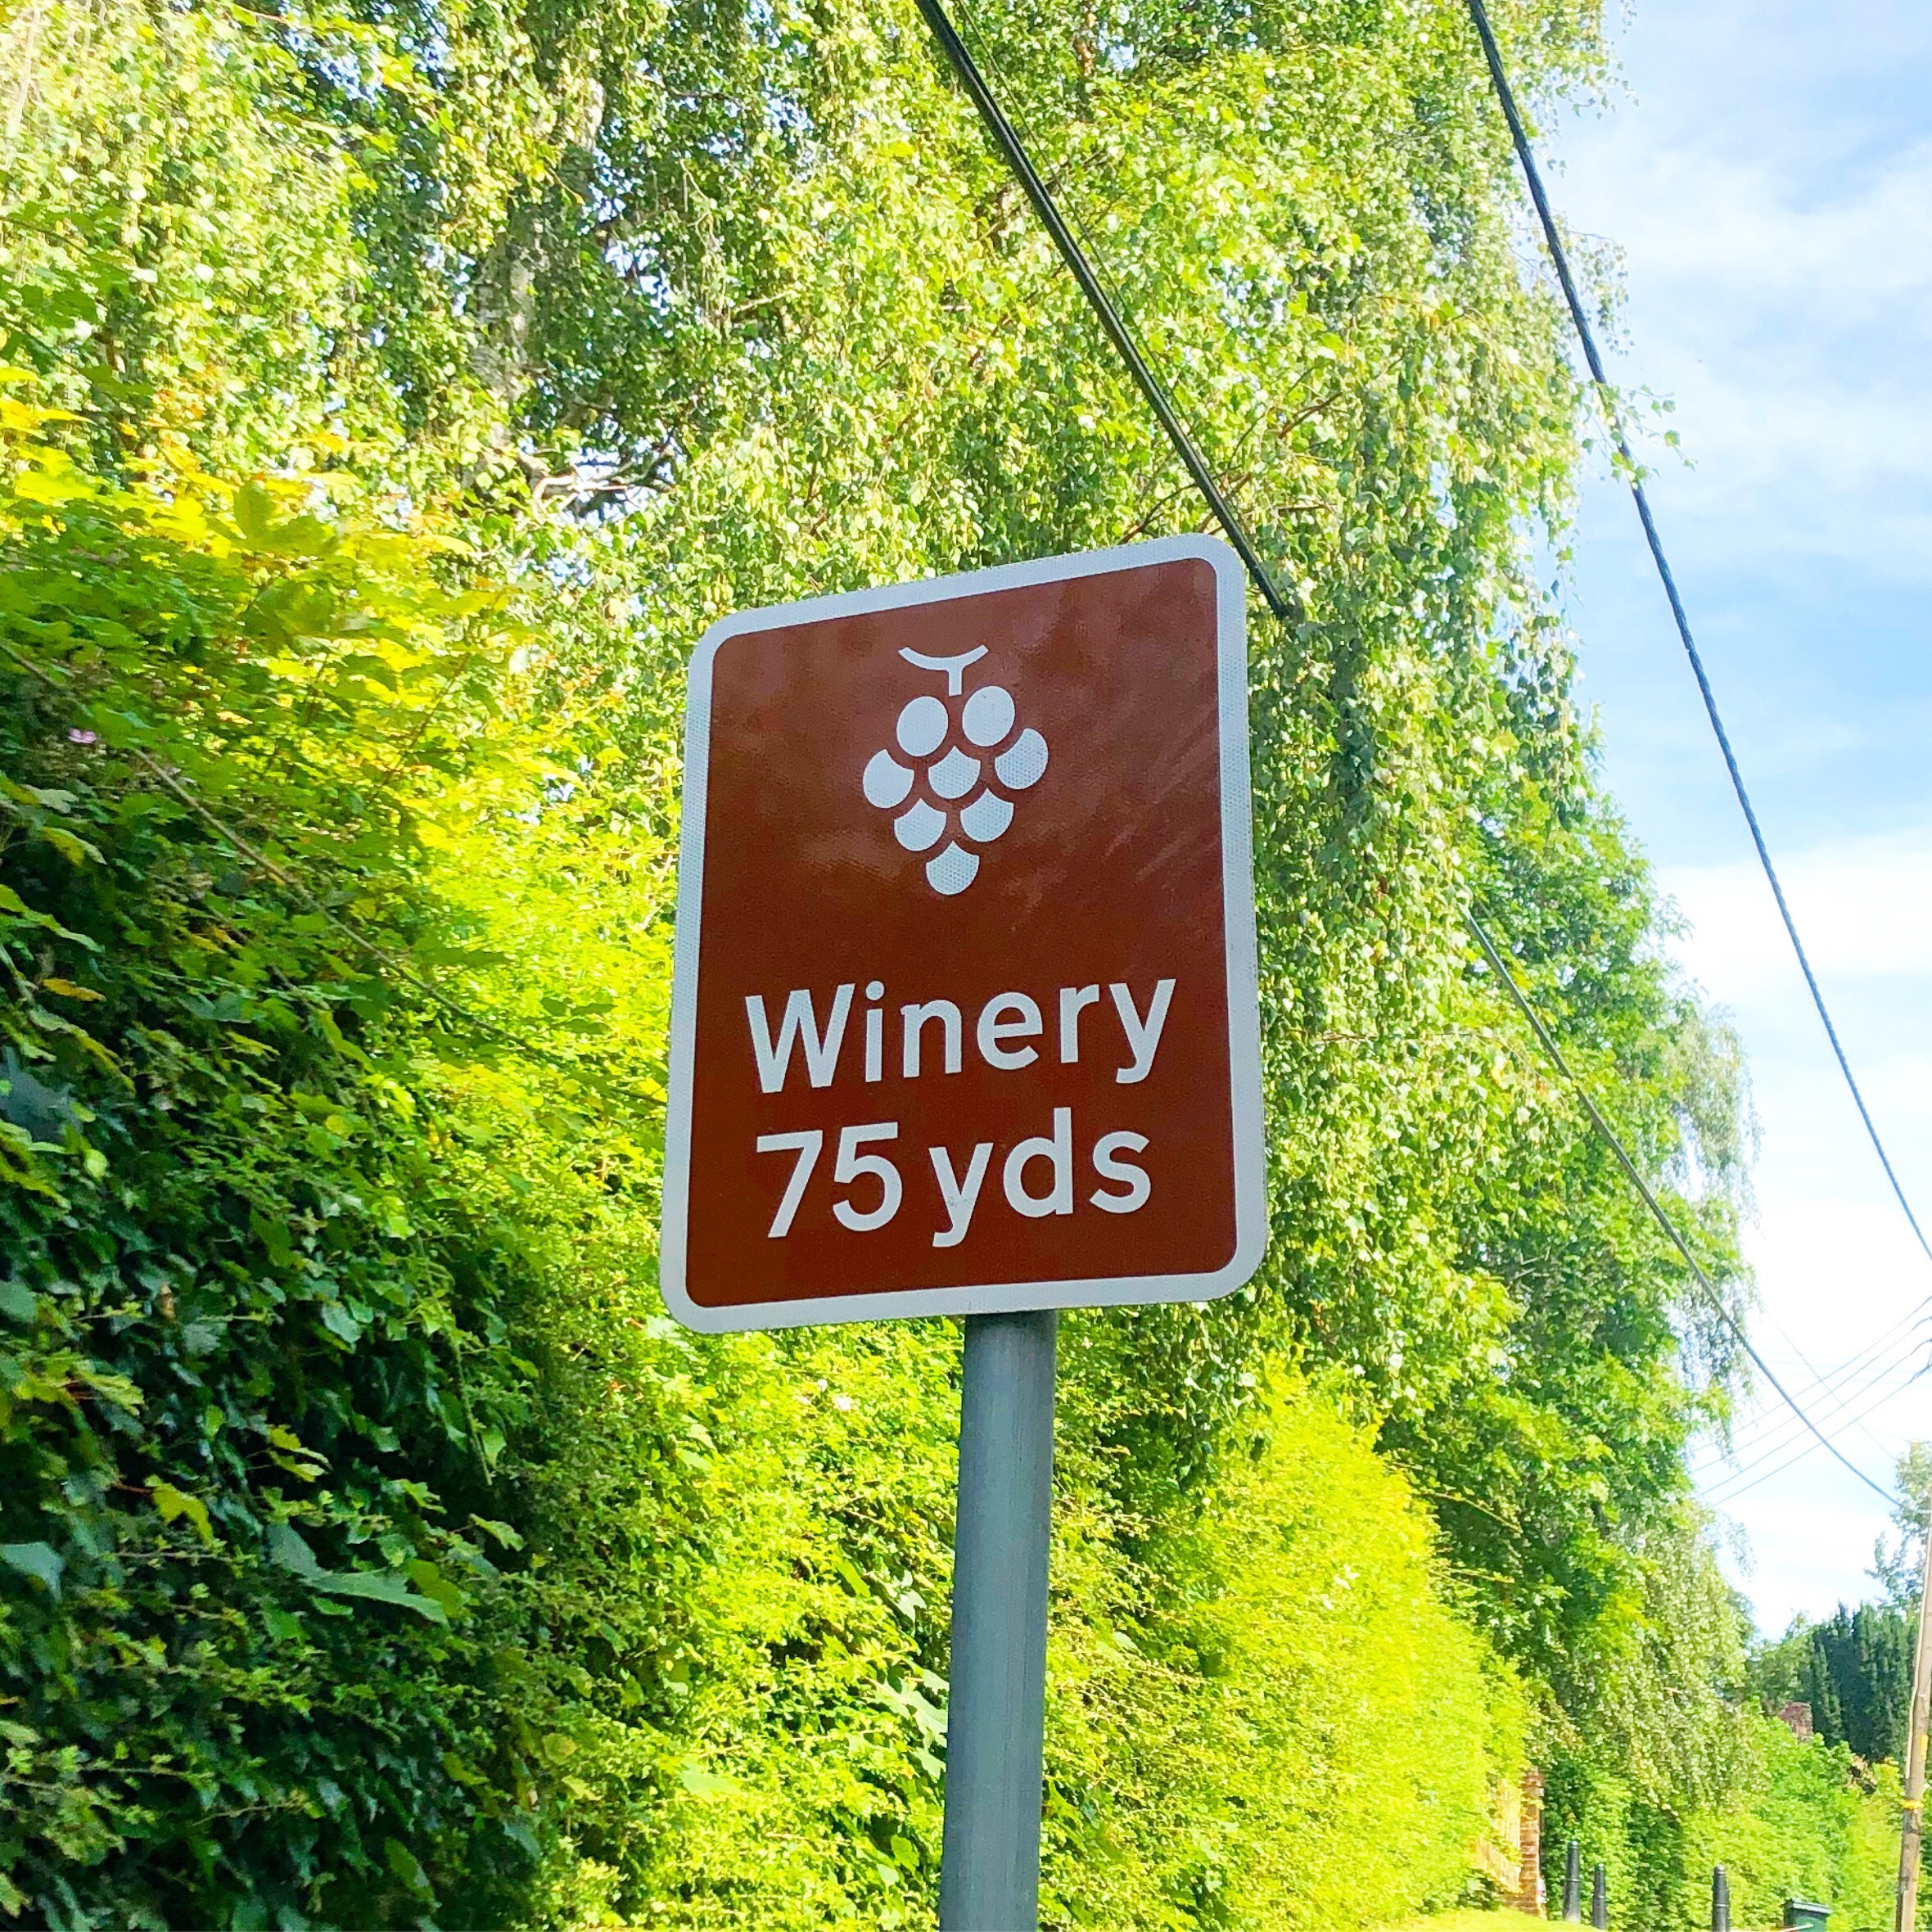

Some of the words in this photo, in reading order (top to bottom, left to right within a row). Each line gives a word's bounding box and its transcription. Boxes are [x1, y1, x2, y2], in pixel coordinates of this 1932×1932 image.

[744, 978, 1176, 1094] Winery
[756, 1122, 903, 1238] 75
[928, 1107, 1151, 1248] yds
